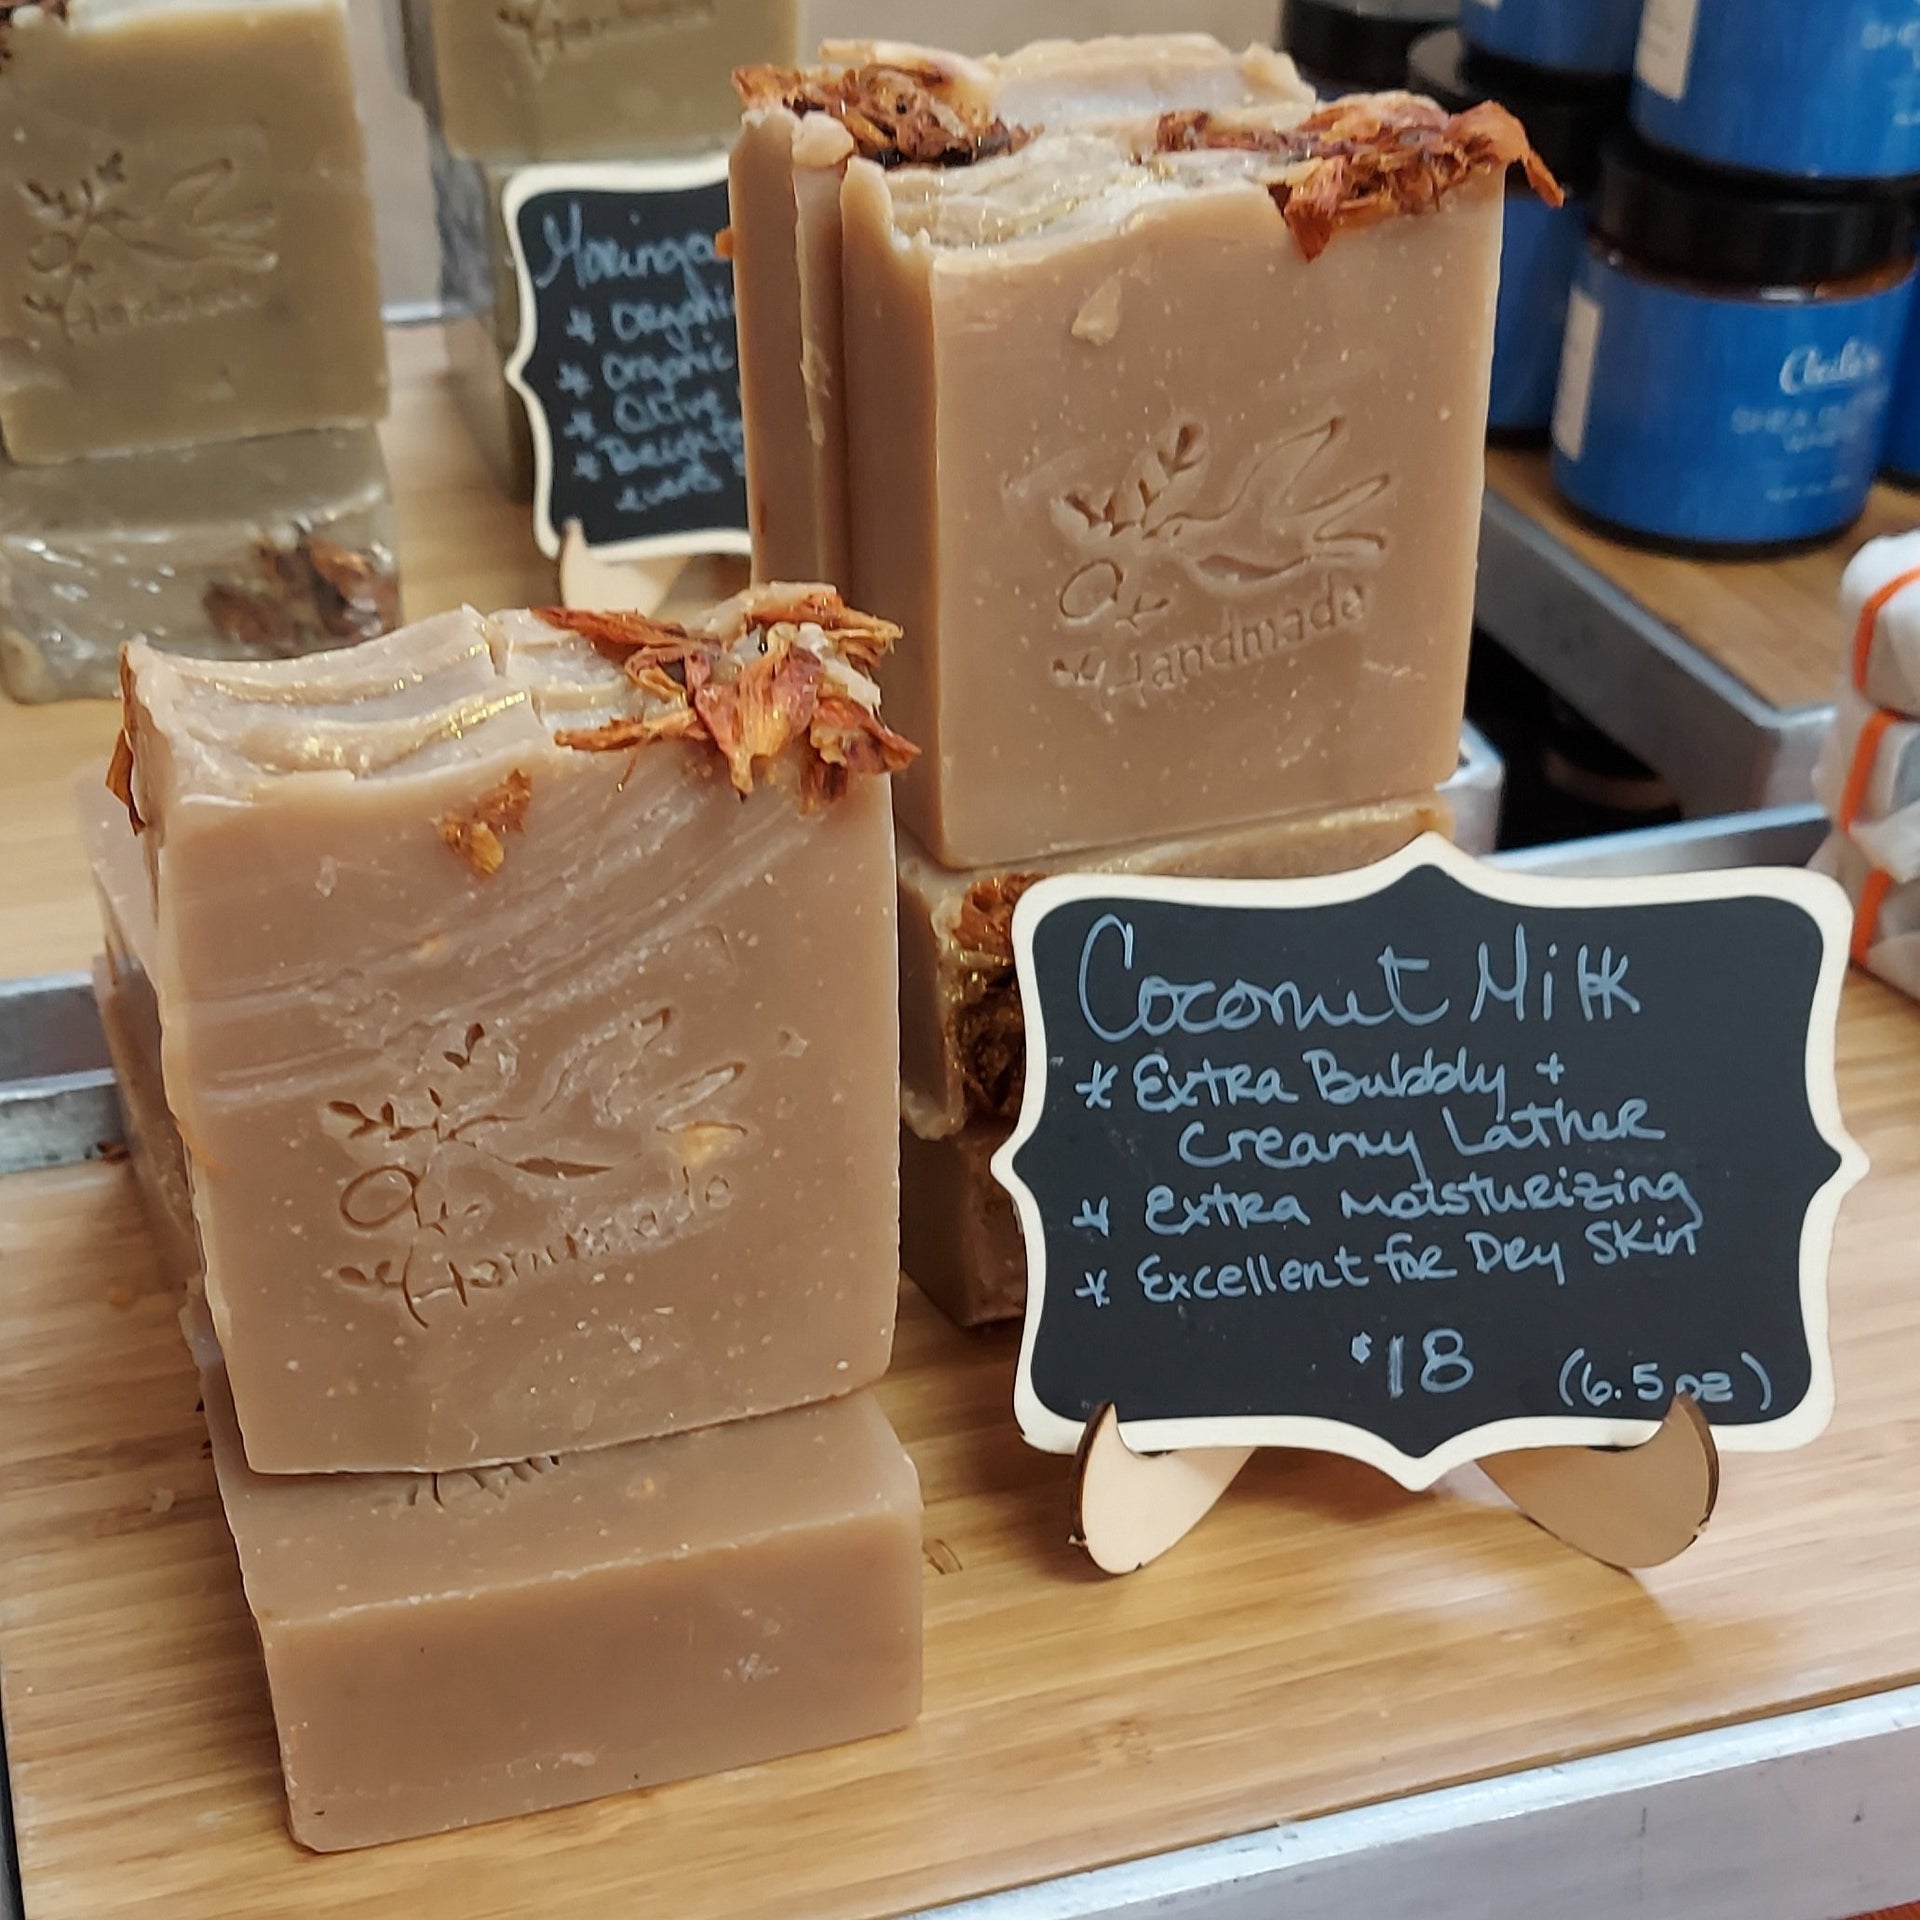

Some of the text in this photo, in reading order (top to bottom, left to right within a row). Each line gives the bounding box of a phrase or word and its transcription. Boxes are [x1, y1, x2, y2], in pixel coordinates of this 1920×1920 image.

[1078, 913, 1642, 1043] Coconut Milk
[1132, 1053, 1299, 1113] Extra
[1302, 1046, 1506, 1122] Bubbly
[1178, 1097, 1666, 1182] Creamy Lather
[1145, 1182, 1312, 1236] Extra
[1137, 1245, 1370, 1303] Excellent
[1374, 1232, 1458, 1284] for
